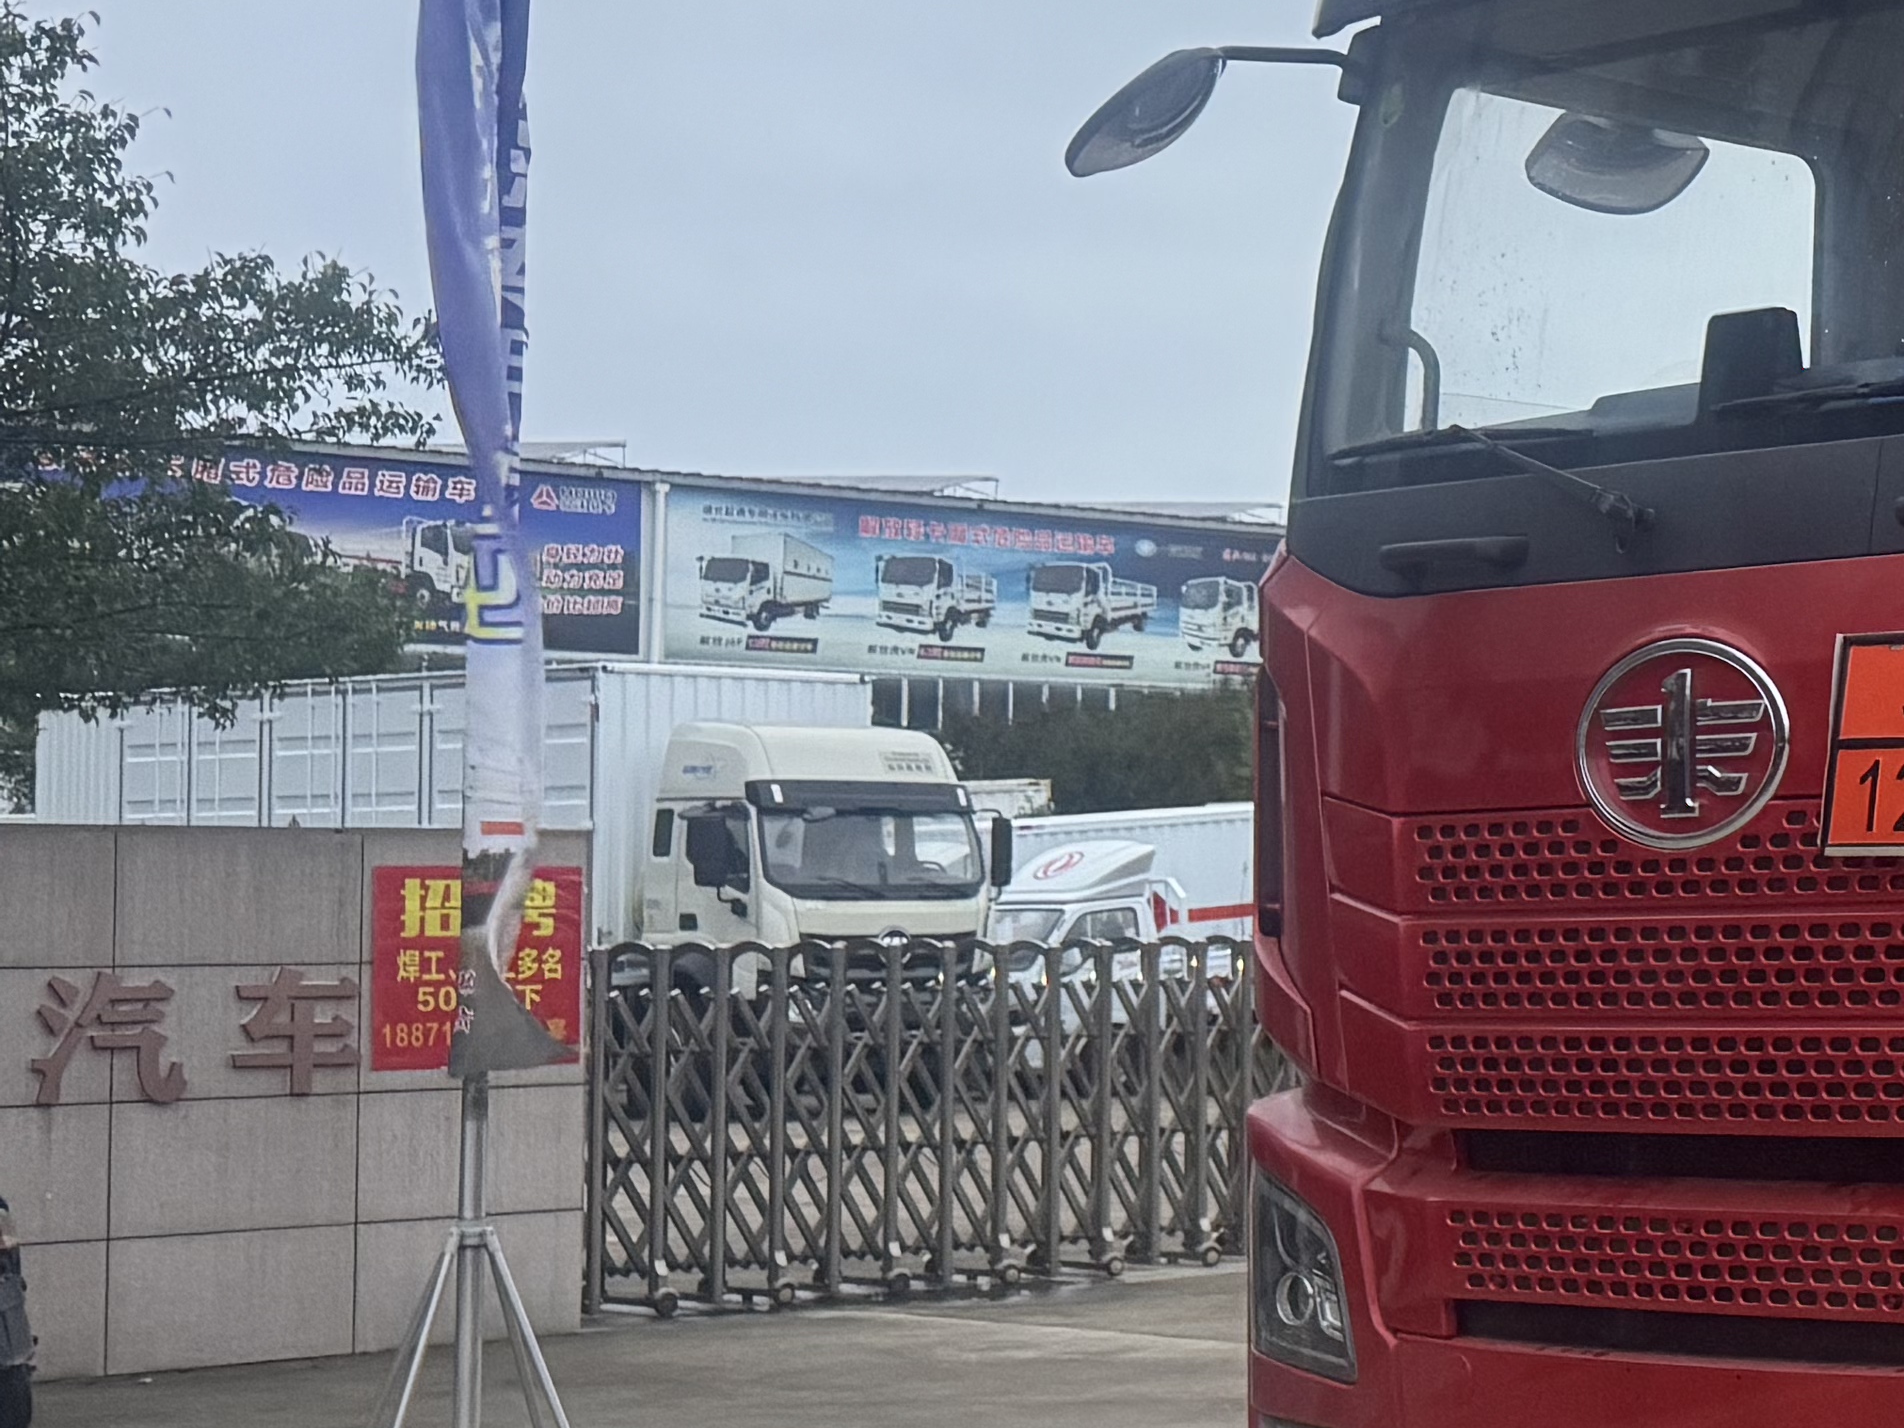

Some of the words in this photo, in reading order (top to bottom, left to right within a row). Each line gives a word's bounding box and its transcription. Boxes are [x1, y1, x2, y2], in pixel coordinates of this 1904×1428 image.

[541, 594, 624, 615] 价比超高
[30, 965, 361, 1105] 汽车
